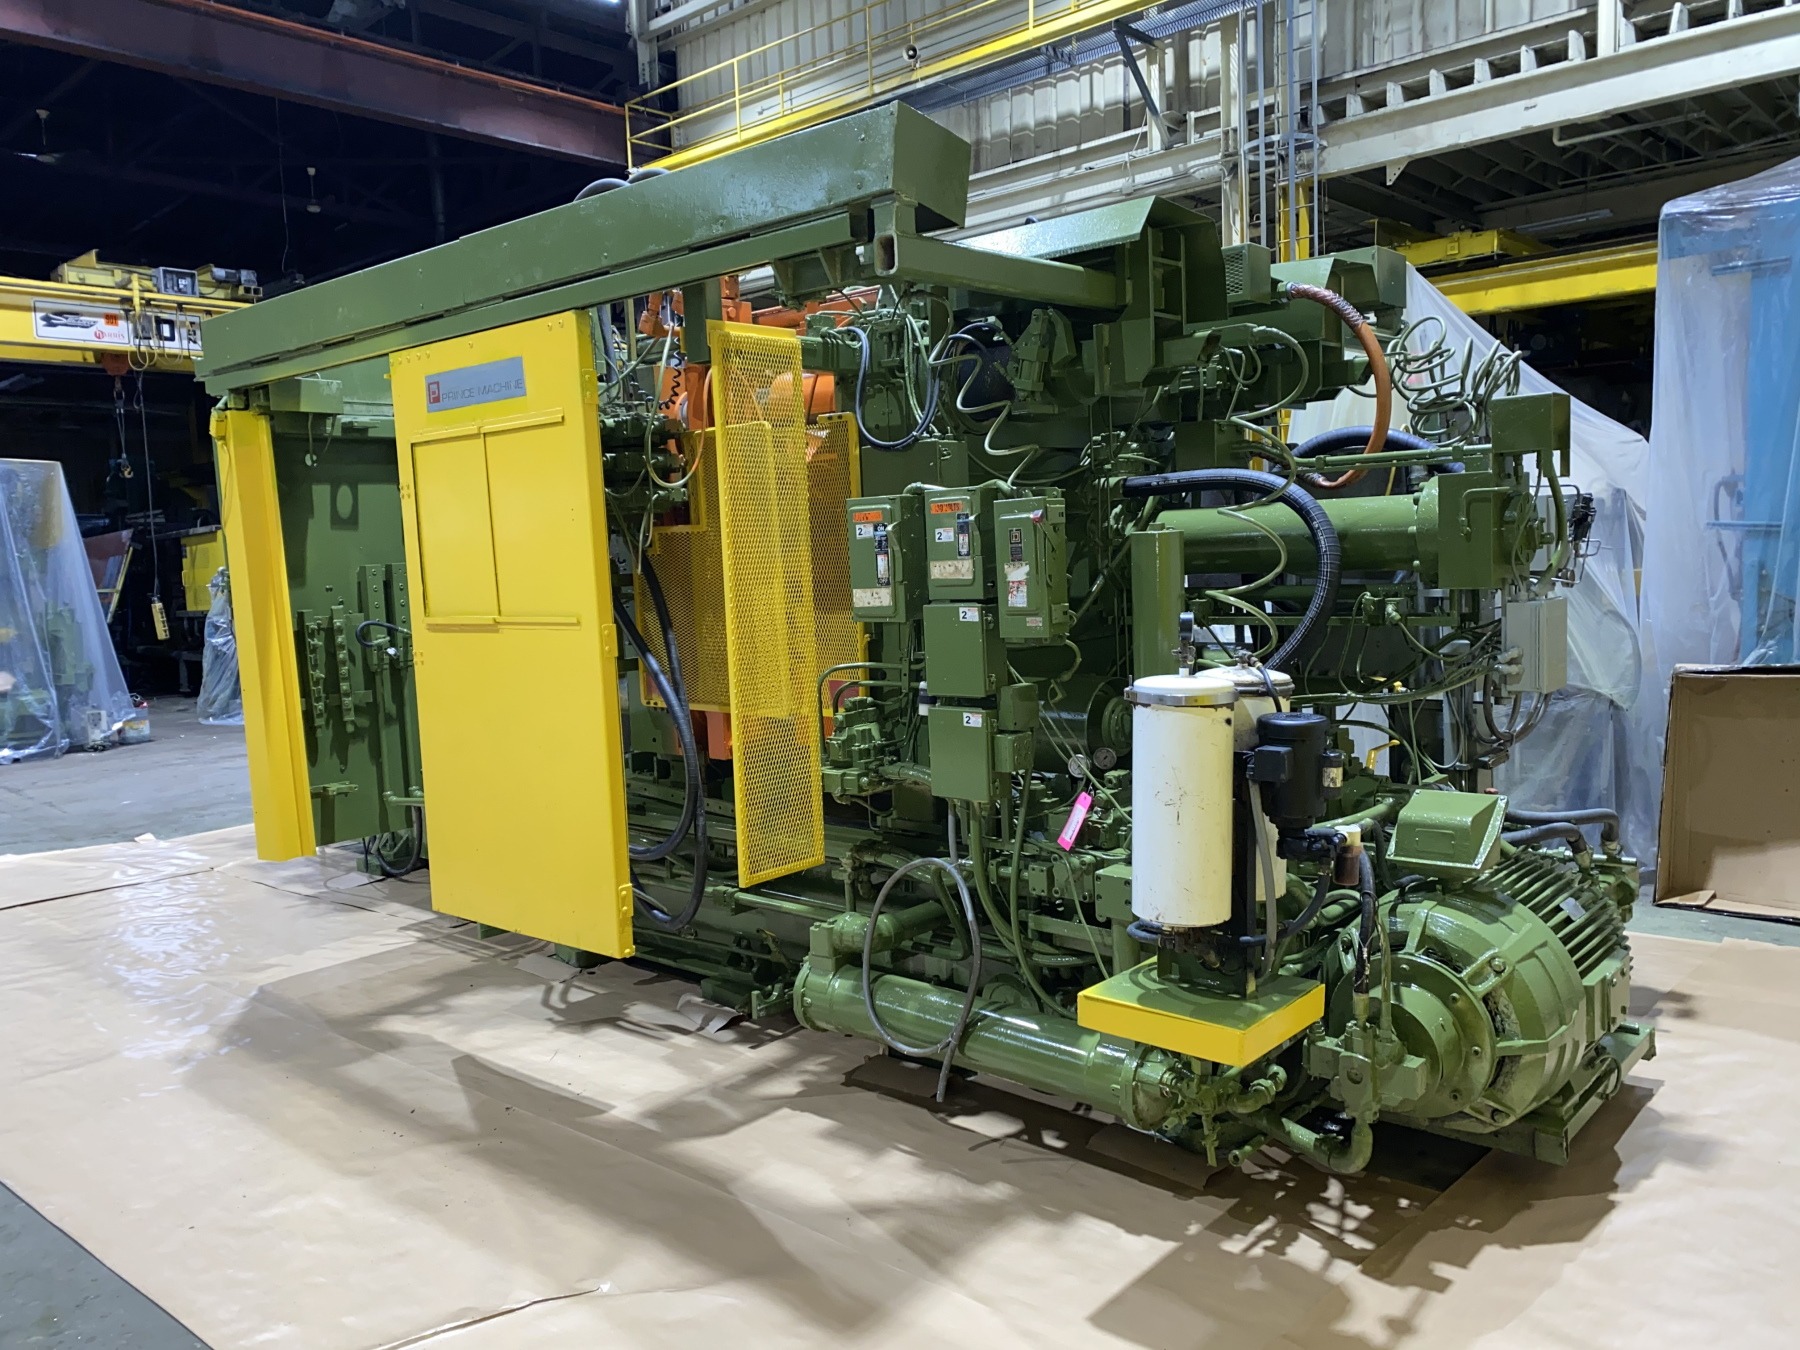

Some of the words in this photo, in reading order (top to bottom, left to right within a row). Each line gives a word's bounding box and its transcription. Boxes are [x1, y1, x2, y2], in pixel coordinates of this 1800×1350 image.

[442, 388, 475, 402] PRINCE
[478, 379, 523, 396] MACHINE
[857, 527, 863, 536] 2
[937, 532, 943, 541] 2
[961, 610, 968, 620] 2
[965, 715, 971, 725] 2
